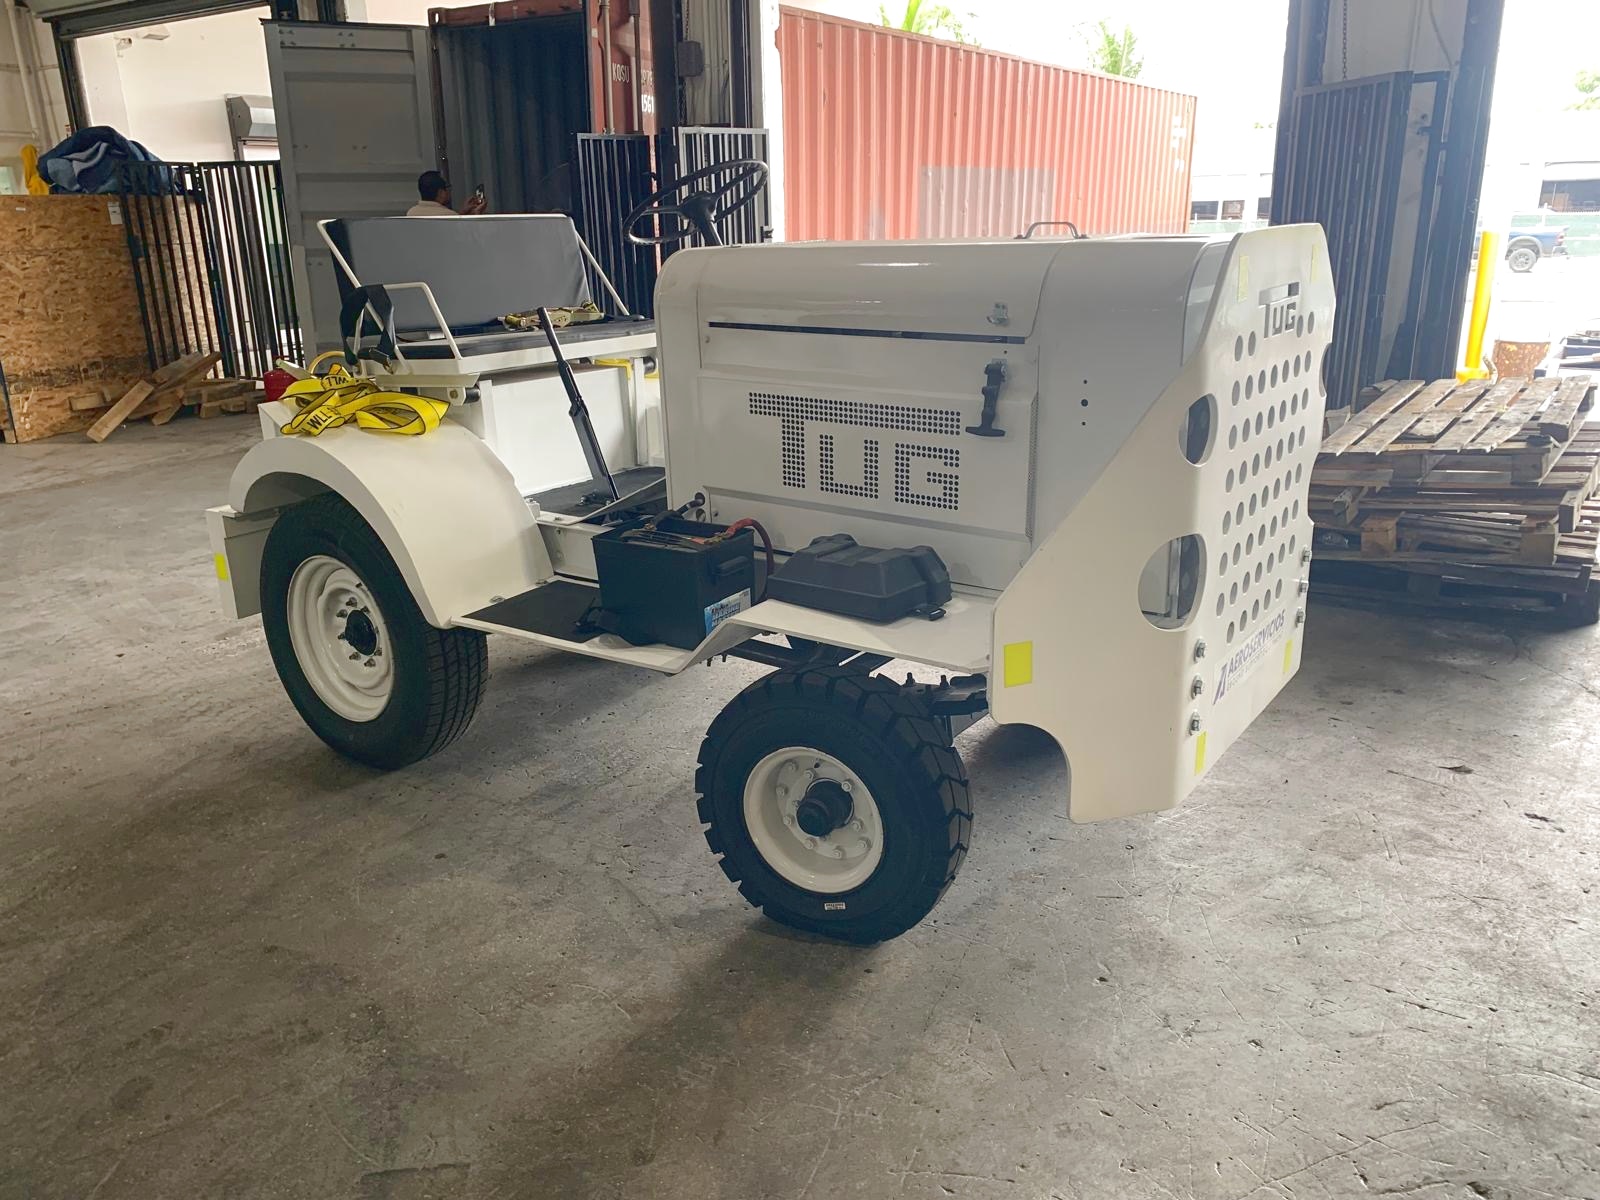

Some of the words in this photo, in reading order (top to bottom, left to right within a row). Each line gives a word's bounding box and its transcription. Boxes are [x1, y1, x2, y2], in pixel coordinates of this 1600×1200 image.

[612, 62, 630, 83] KOSU
[1258, 282, 1300, 339] TUG
[306, 409, 333, 431] WLL
[748, 391, 961, 511] TUG
